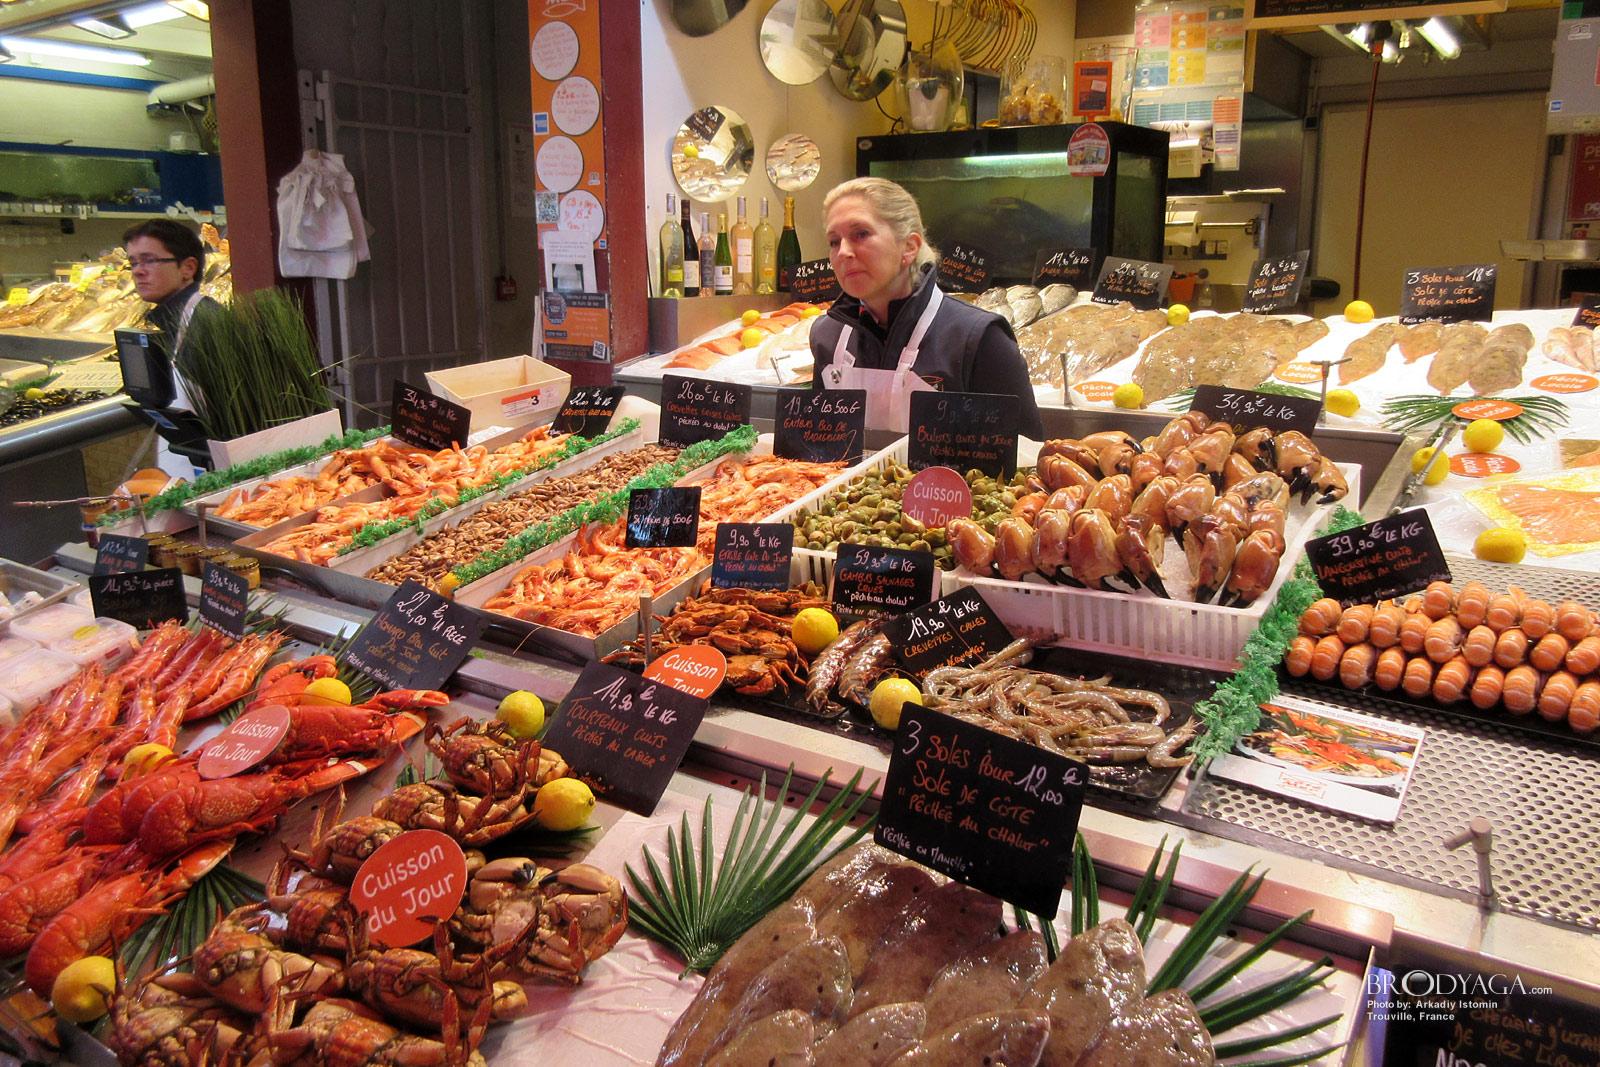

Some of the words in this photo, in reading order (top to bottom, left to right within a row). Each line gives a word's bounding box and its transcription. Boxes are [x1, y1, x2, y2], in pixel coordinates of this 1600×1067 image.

[1407, 272, 1420, 284] 3
[1465, 268, 1484, 282] 18
[531, 395, 540, 406] 3
[1276, 405, 1296, 420] KG
[1474, 407, 1513, 417] Locale
[913, 482, 962, 503] Cuisson
[909, 505, 924, 524] du
[930, 508, 967, 528] Jour
[769, 536, 781, 548] KG
[1385, 530, 1398, 543] LE
[1401, 522, 1424, 539] KG
[901, 559, 915, 572] KG
[858, 583, 884, 593] CRUES
[876, 576, 915, 588] SAUVAGES
[962, 600, 980, 613] KG
[429, 642, 448, 660] Cuit
[904, 632, 953, 657] CREVETTES
[663, 654, 718, 679] Cuisson
[649, 673, 665, 686] du
[669, 678, 704, 696] Jour
[658, 709, 678, 725] KG
[231, 718, 280, 739] Cuisson
[207, 741, 226, 757] du
[225, 742, 260, 762] Jour
[902, 719, 922, 755] 3
[978, 752, 1015, 785] POUR
[957, 784, 979, 805] DE
[989, 797, 1035, 824] CÔTE
[959, 816, 979, 833] AU
[361, 843, 445, 899] Cuisson
[368, 904, 397, 933] du
[402, 872, 455, 915] Jour
